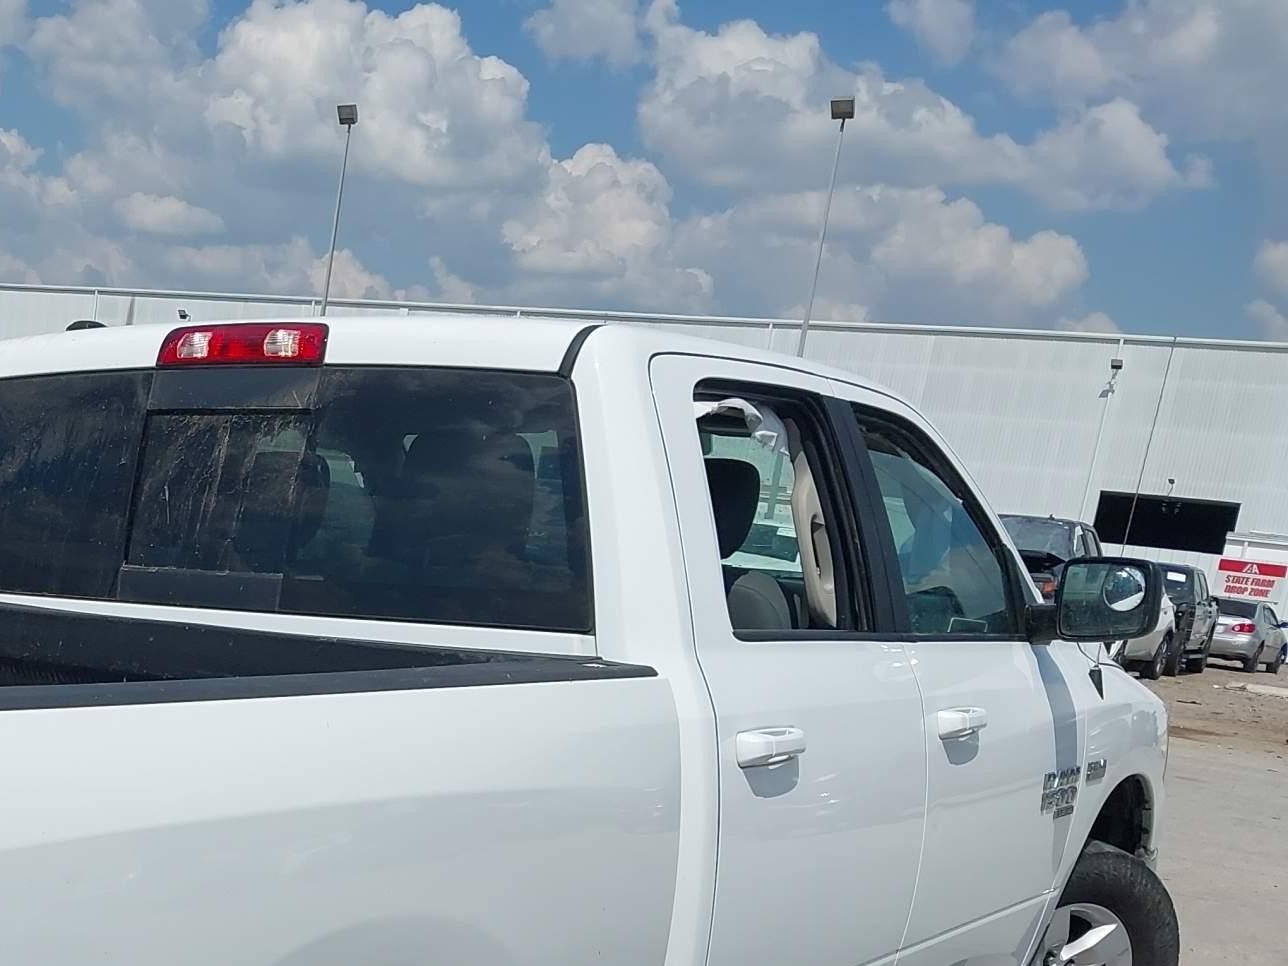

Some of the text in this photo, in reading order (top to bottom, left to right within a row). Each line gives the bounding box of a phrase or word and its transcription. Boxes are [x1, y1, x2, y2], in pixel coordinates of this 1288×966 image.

[1225, 574, 1275, 588] STATE FARM
[1224, 584, 1271, 598] DROP ZONE
